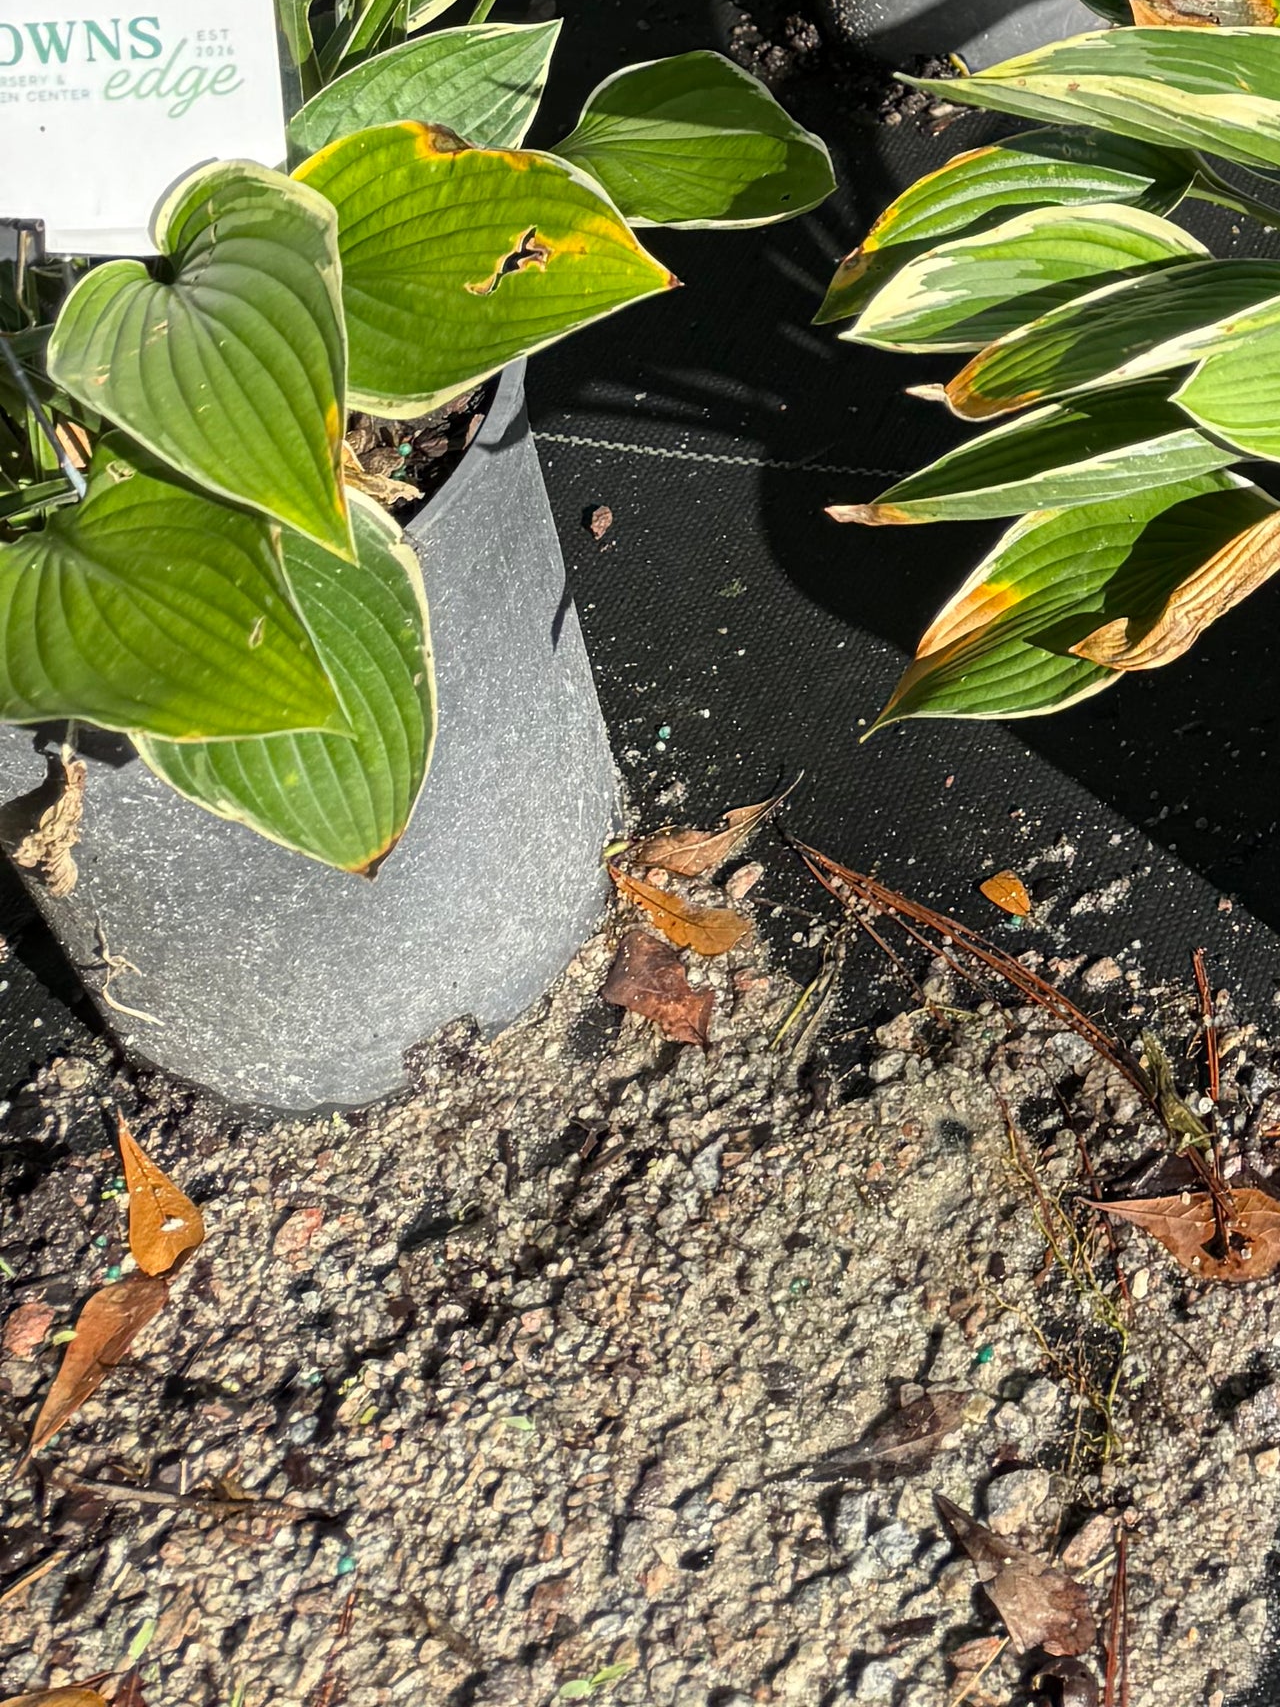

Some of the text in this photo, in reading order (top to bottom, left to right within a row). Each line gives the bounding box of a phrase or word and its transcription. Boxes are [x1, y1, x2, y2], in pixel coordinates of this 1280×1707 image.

[196, 28, 230, 42] EST
[103, 37, 245, 119] edge
[26, 88, 91, 103] CENTER
